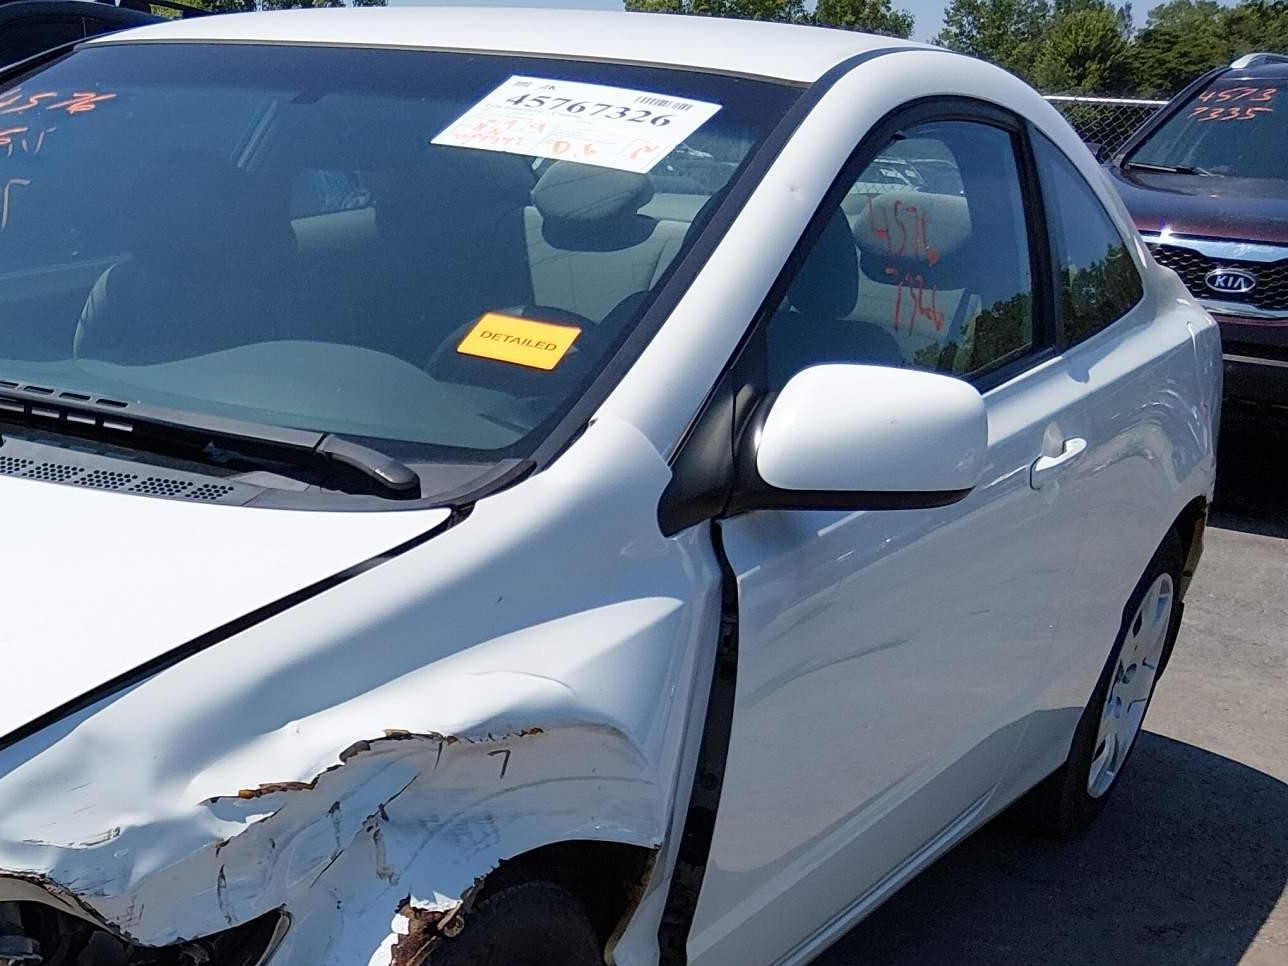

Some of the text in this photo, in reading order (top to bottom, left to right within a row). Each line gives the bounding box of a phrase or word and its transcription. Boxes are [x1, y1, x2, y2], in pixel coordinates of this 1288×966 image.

[1198, 86, 1278, 103] 4573
[504, 93, 674, 127] 45767326
[1187, 106, 1274, 122] 7335
[1214, 275, 1248, 291] KIA
[479, 330, 558, 352] DETAILED
